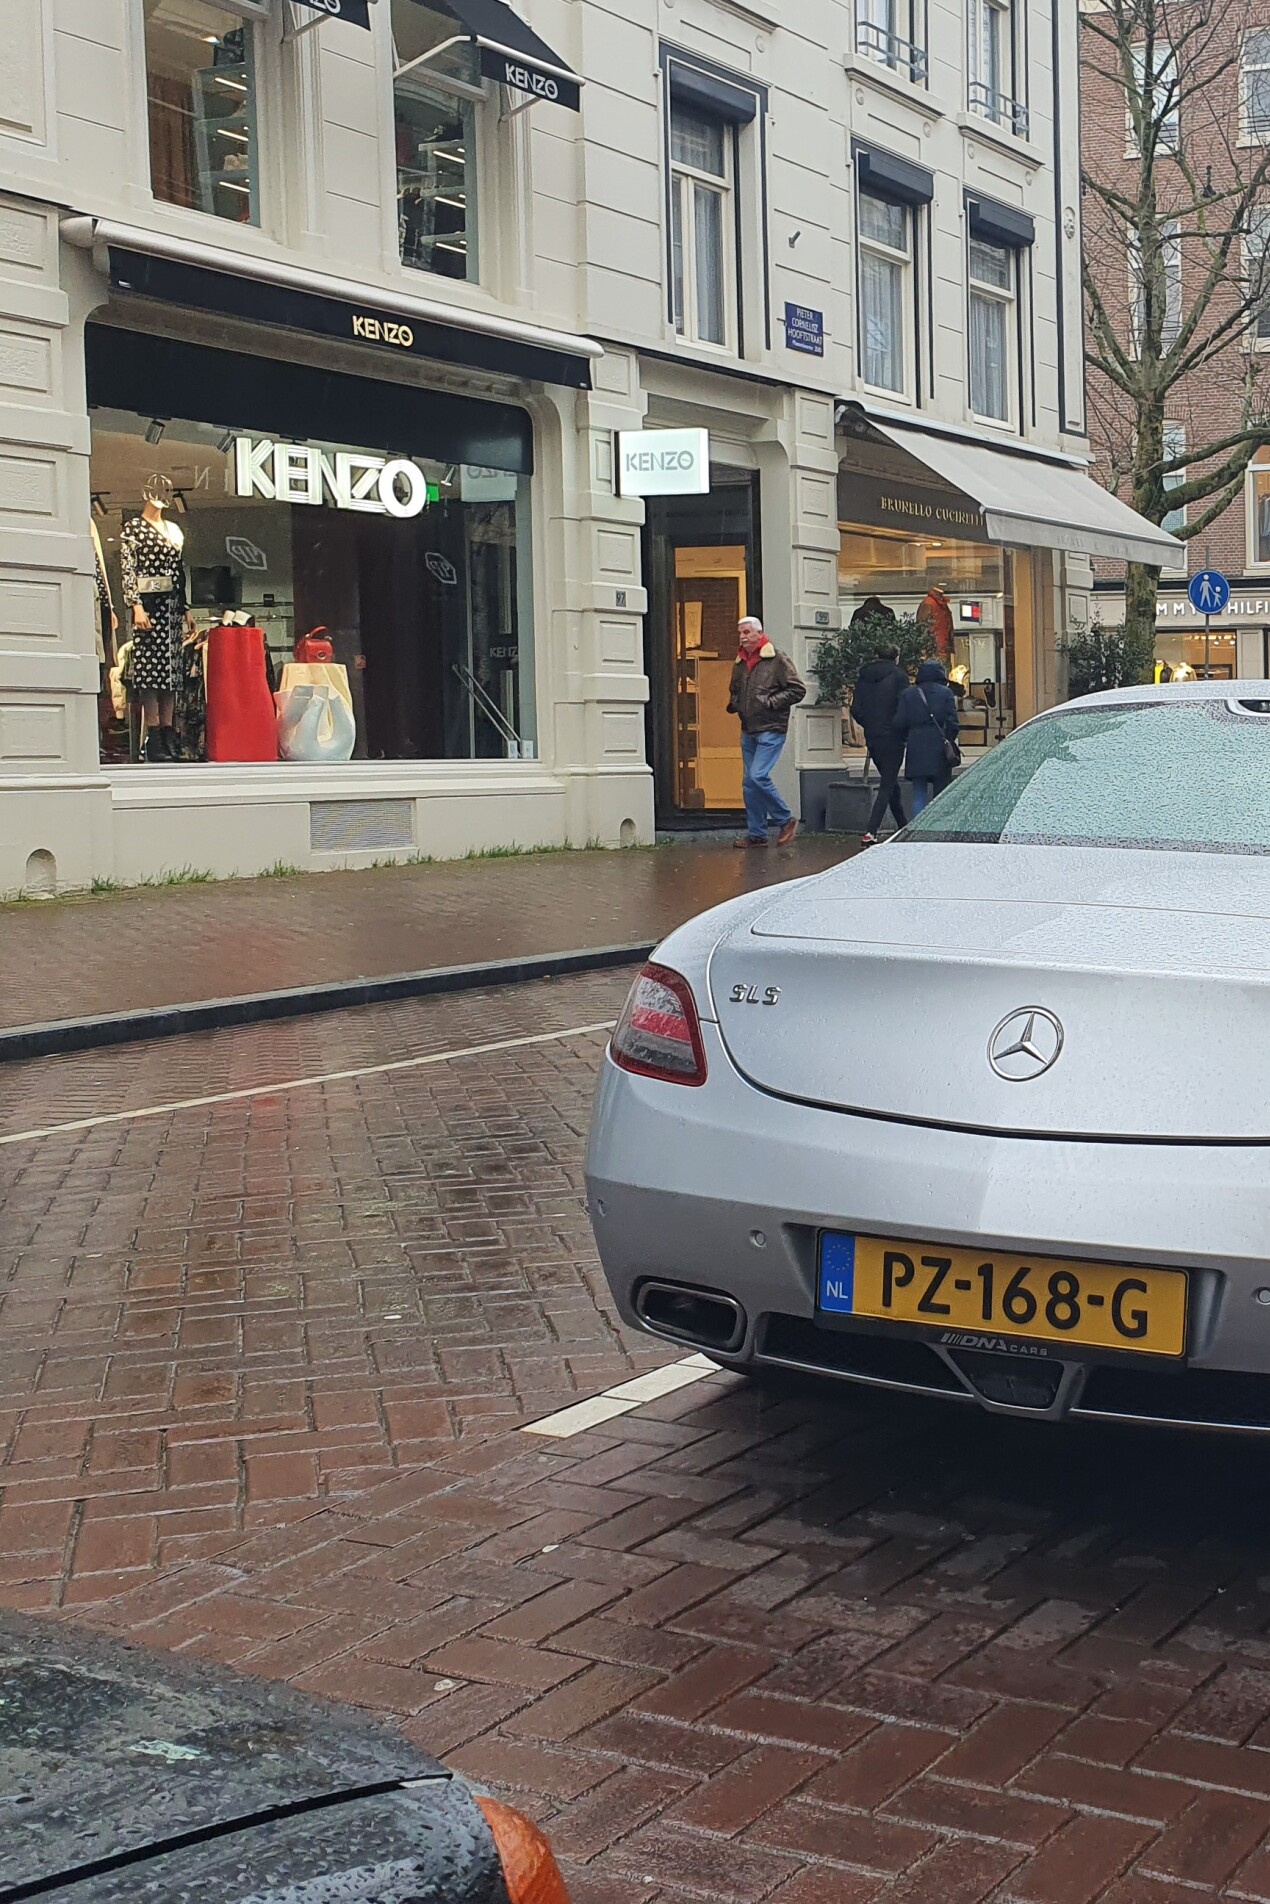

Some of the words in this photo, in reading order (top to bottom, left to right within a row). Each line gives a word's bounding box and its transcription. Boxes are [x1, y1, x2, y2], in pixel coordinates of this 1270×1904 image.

[505, 62, 558, 99] KENZO
[352, 314, 414, 347] KENZO
[626, 450, 694, 472] KENZO
[235, 437, 427, 519] KENZO
[881, 496, 932, 518] BRUNELLO
[729, 983, 782, 1006] SLS
[826, 1279, 849, 1299] NL
[882, 1250, 1149, 1339] PZ-168-G
[1010, 1344, 1048, 1356] CARS
